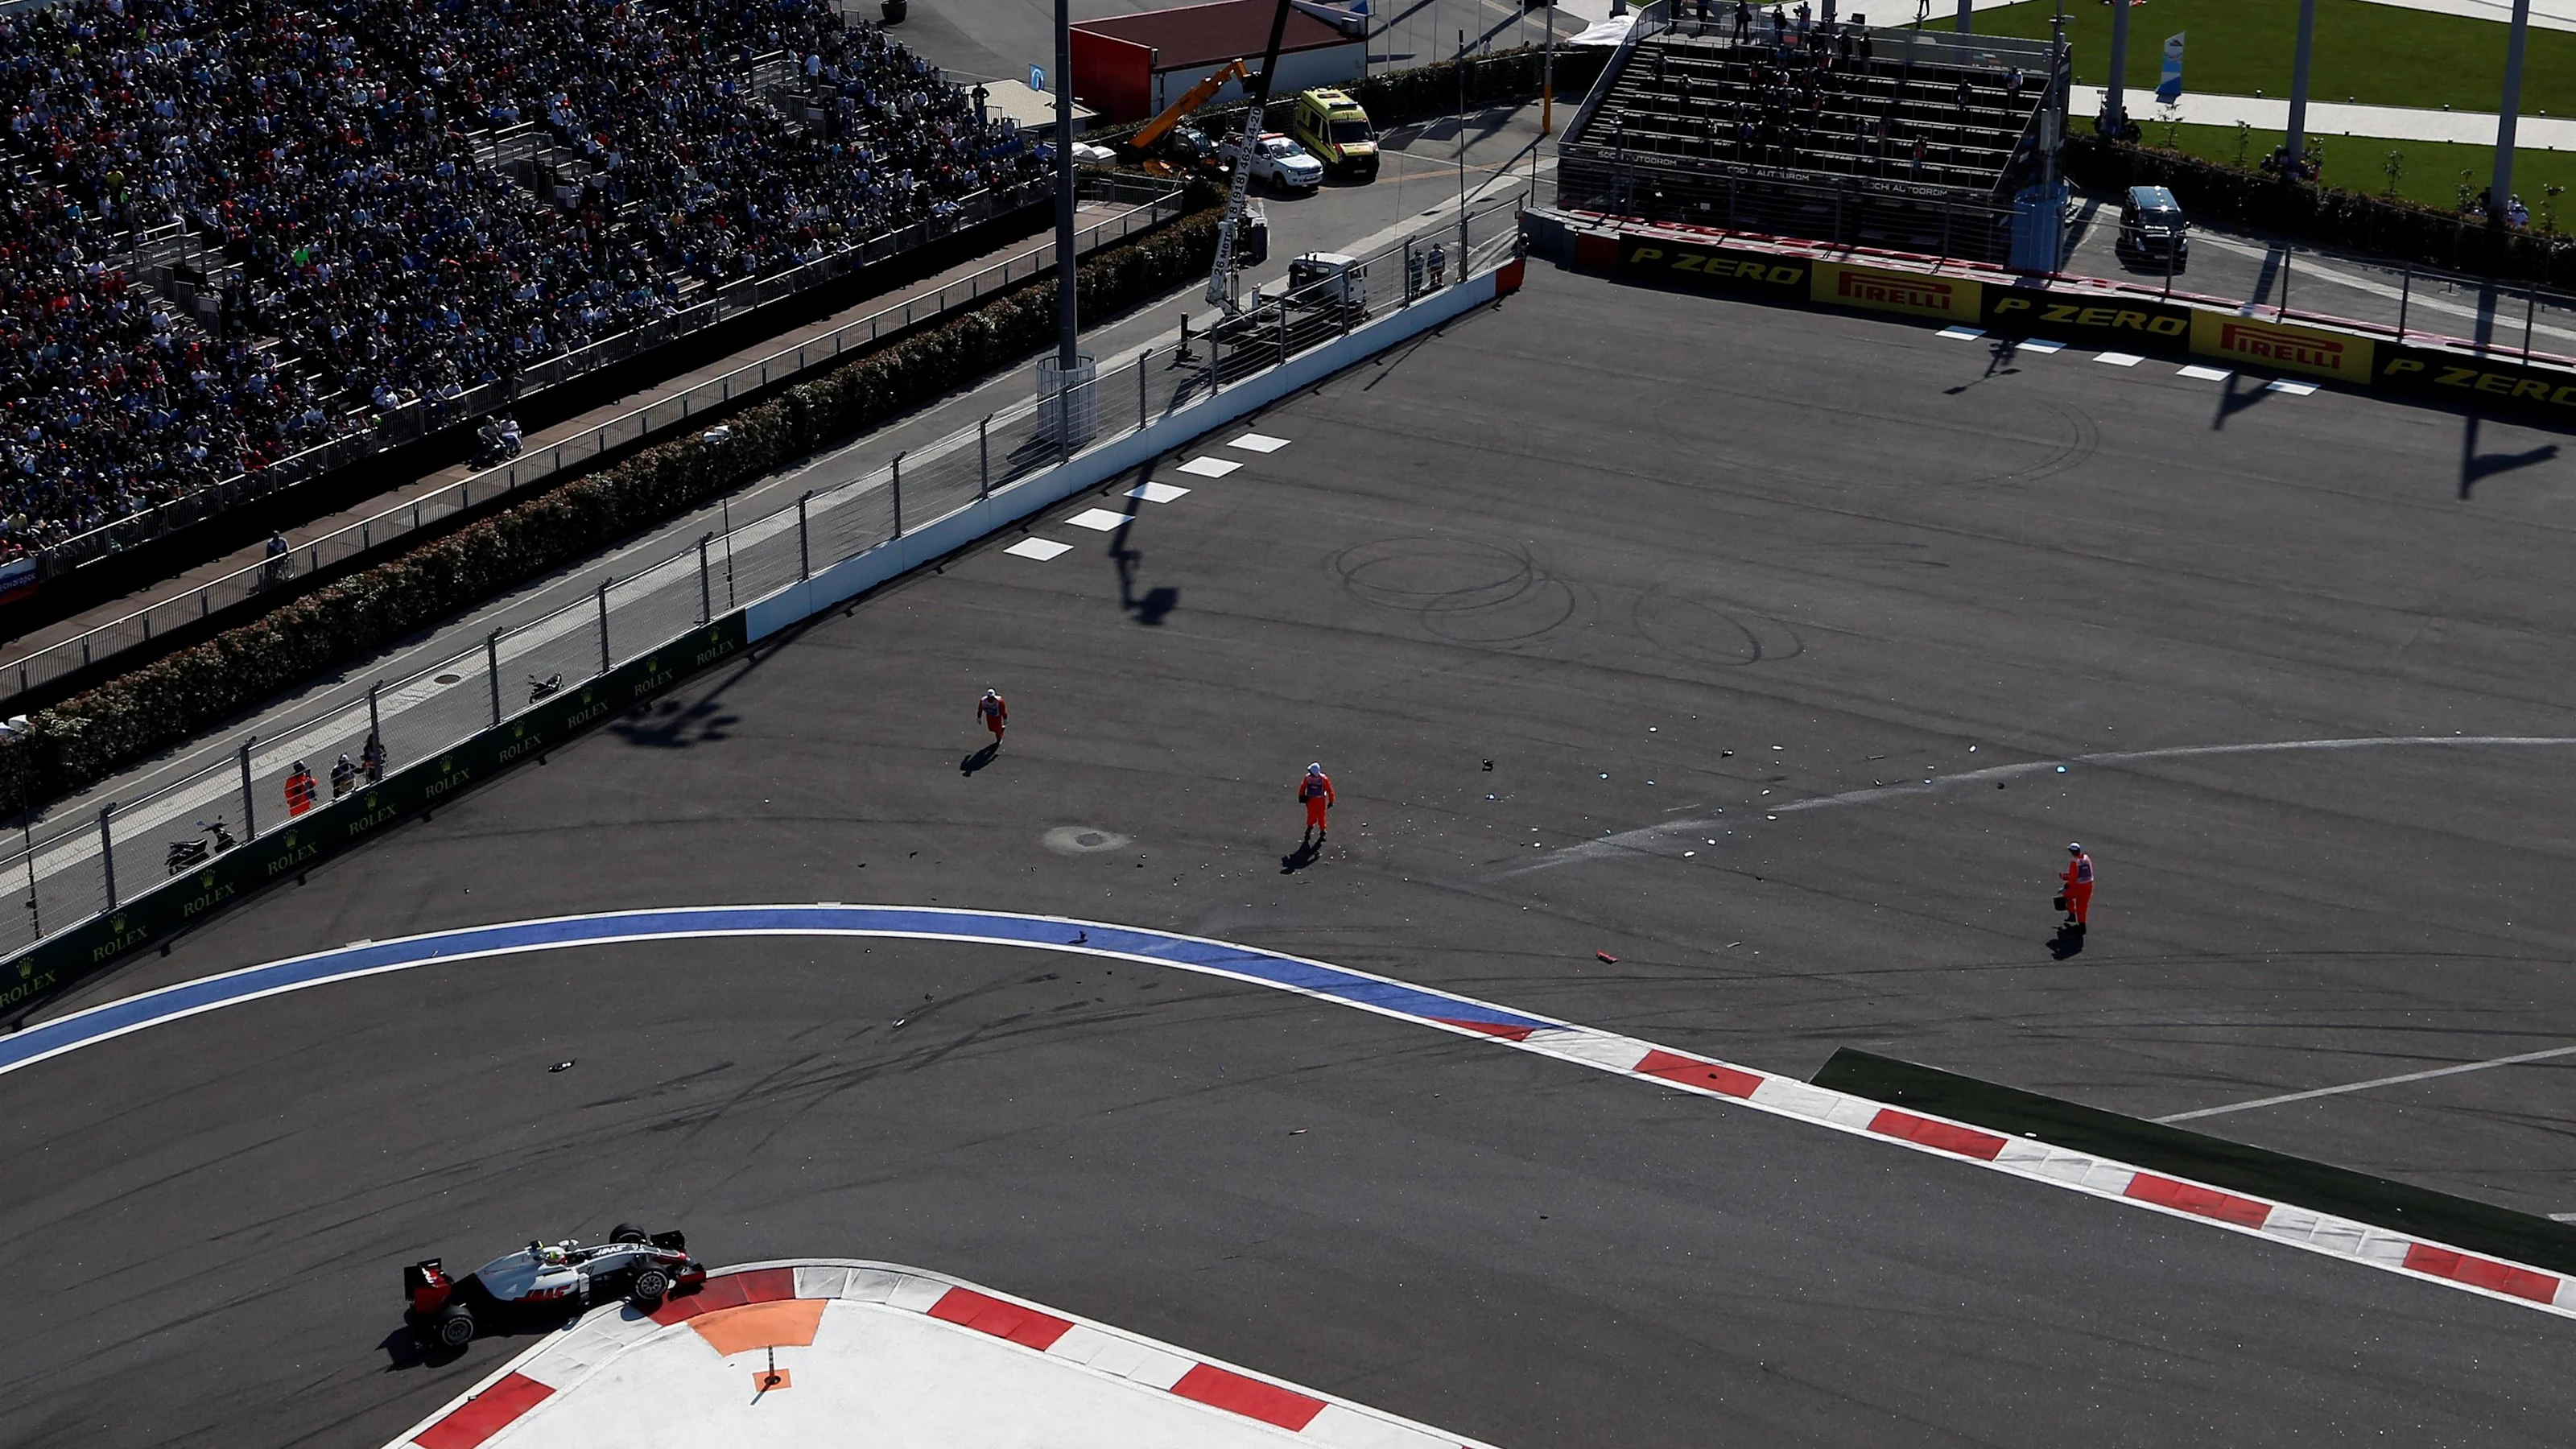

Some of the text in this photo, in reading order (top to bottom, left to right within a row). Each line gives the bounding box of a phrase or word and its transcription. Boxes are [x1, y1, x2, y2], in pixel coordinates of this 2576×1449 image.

[1231, 172, 1249, 204] (918)
[1241, 108, 1261, 169] 462-44-20
[1597, 151, 1677, 167] SOCI UTODROM
[1757, 168, 1810, 181] AUTDROM
[1861, 180, 1889, 191] OCHI
[1214, 260, 1225, 277] 26
[1630, 247, 1803, 284] P ZERO
[1838, 270, 1953, 310] PIRELLI
[1993, 297, 2188, 336] P ZERO
[2220, 323, 2344, 369] PIRELLI
[2384, 357, 2576, 407] P ZERO
[696, 640, 735, 665] ROLEX
[634, 669, 674, 697] ROLEX
[568, 700, 609, 729] ROLEX
[499, 733, 542, 763] ROLEX
[425, 767, 471, 799] ROLEX
[349, 804, 397, 836] ROLEX
[268, 841, 319, 876] ROLEX
[183, 881, 236, 918] ROLEX
[93, 925, 148, 962] ROLEX
[0, 969, 57, 1008] ROLEX
